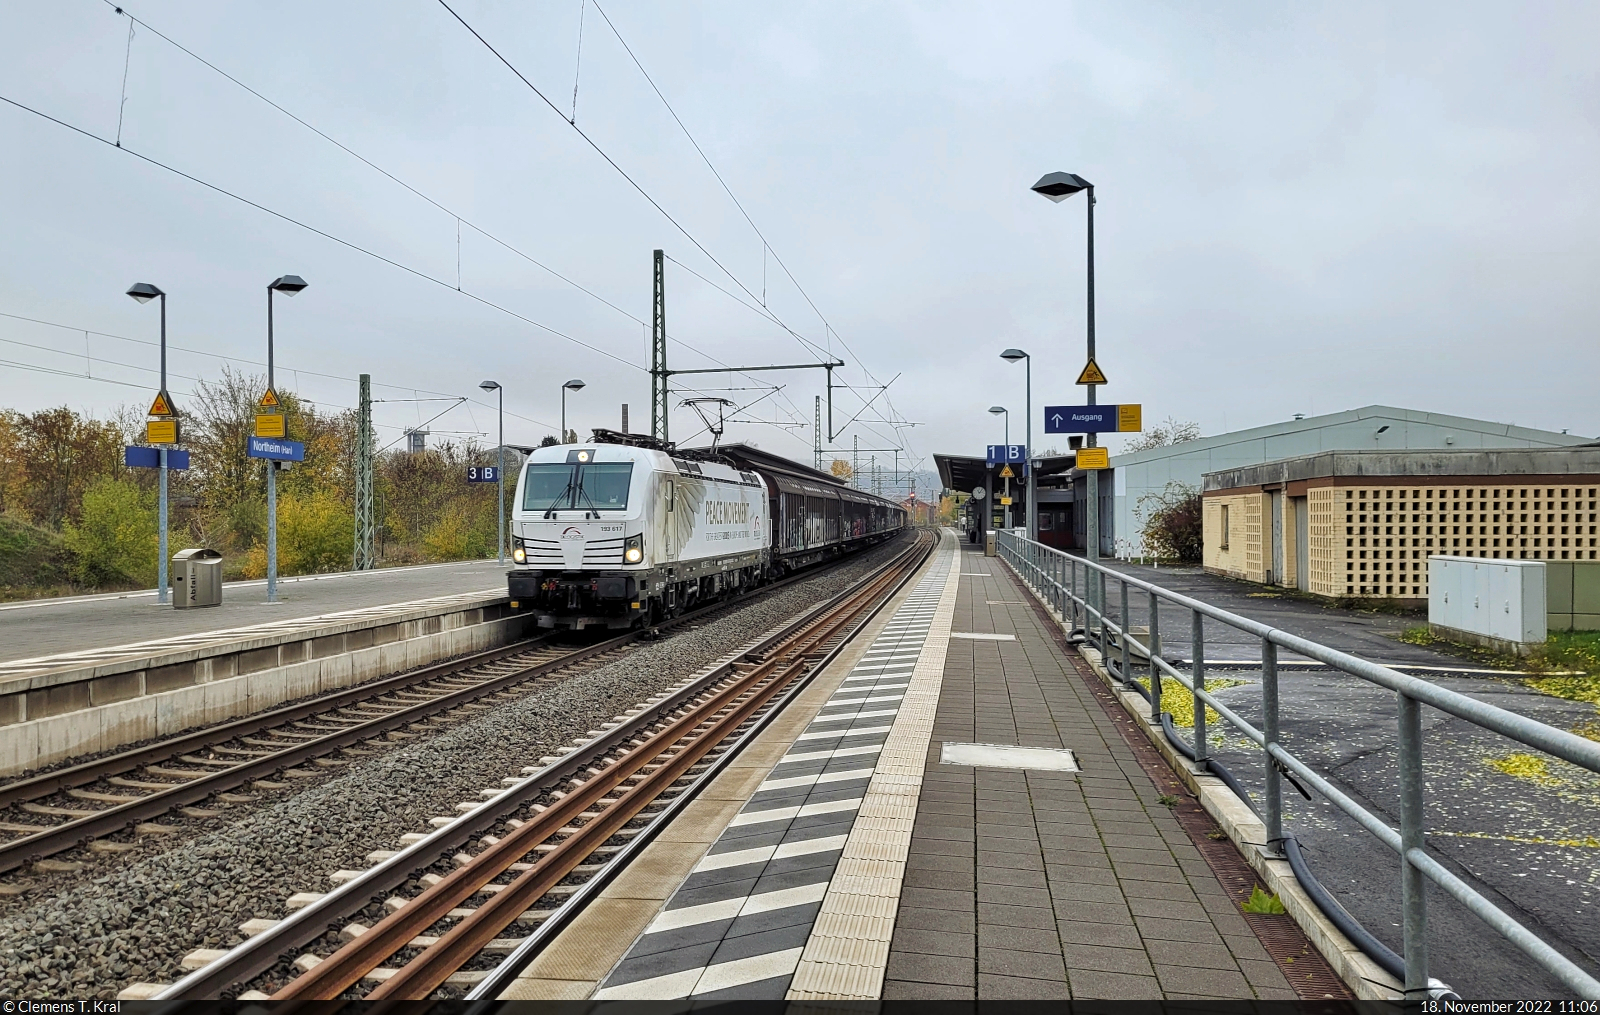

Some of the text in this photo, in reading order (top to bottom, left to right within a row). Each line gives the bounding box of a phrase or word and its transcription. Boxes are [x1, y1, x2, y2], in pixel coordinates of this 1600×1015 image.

[1071, 413, 1102, 422] Ausgang
[253, 440, 293, 455] Northeim (Han)
[989, 446, 1019, 459] 1 B
[469, 467, 493, 479] 3 B
[706, 500, 723, 525] PEACE
